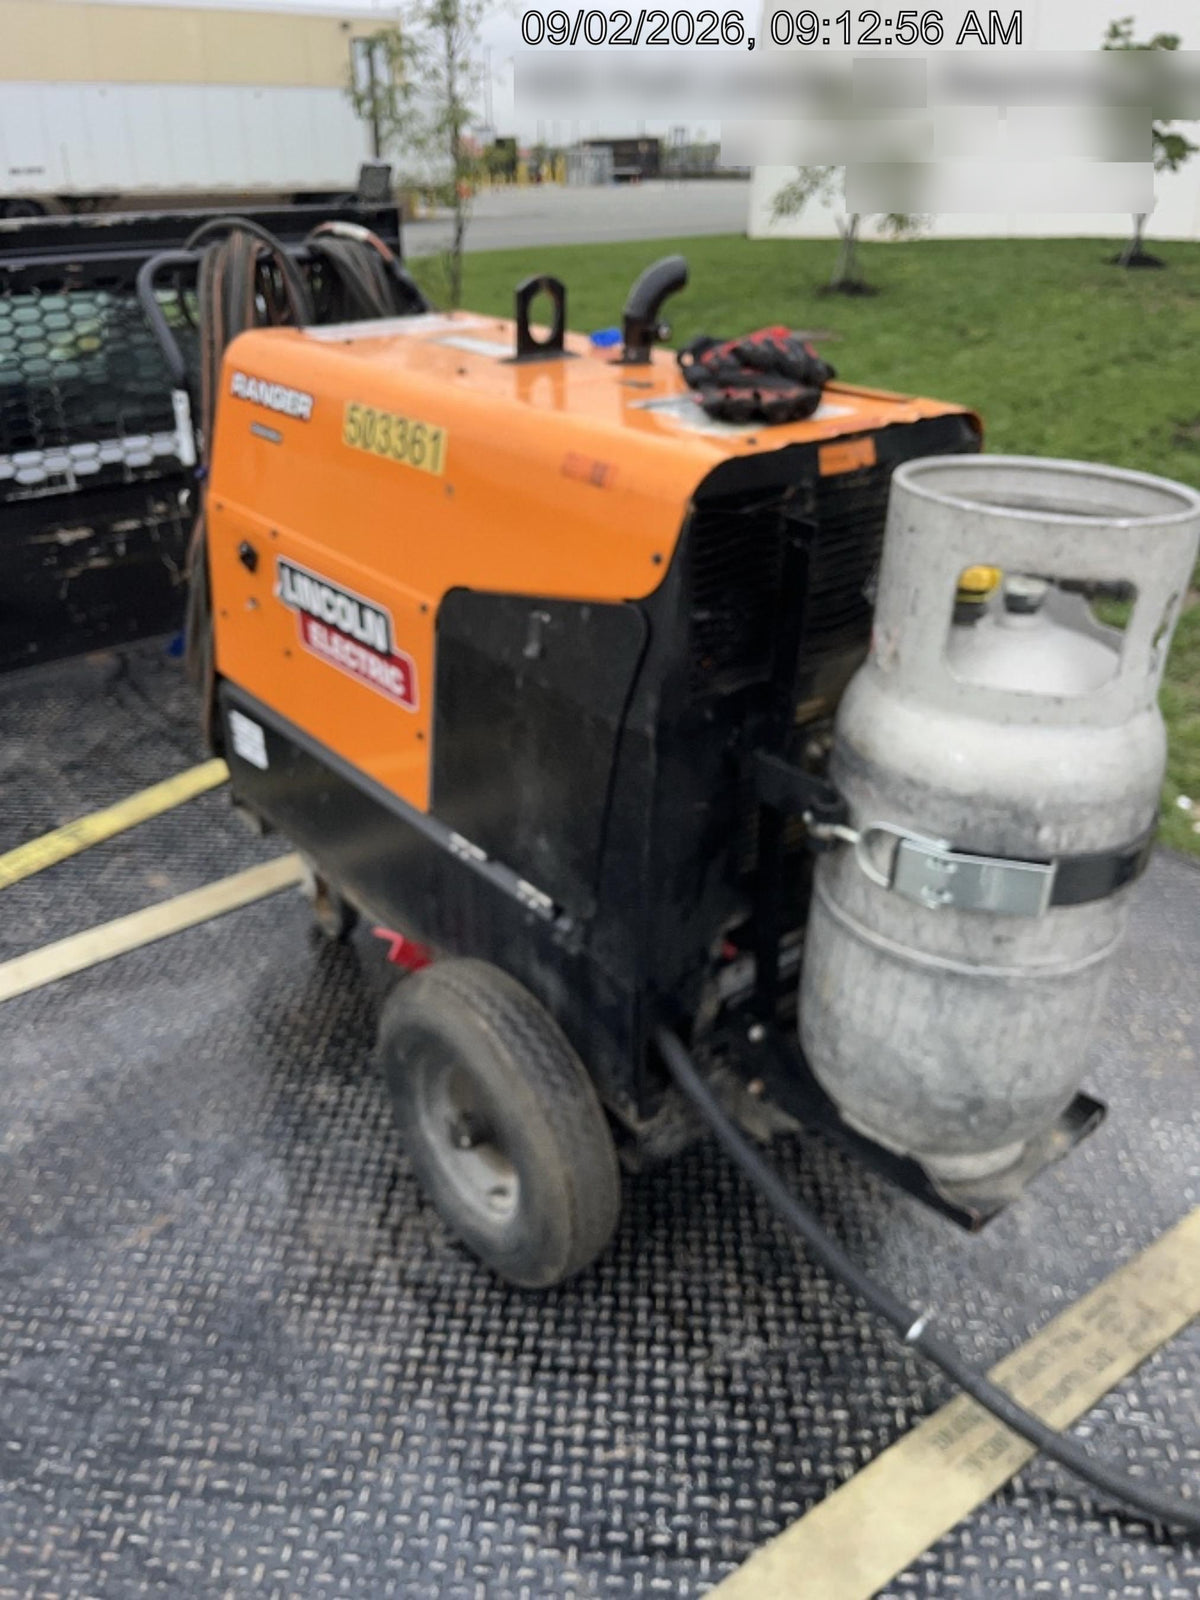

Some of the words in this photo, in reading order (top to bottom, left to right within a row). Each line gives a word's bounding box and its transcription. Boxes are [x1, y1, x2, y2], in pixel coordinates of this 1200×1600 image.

[231, 371, 314, 421] RANGER
[345, 403, 443, 473] 503361
[280, 566, 389, 653] LINCOLN
[306, 620, 407, 697] ELECTRIC
